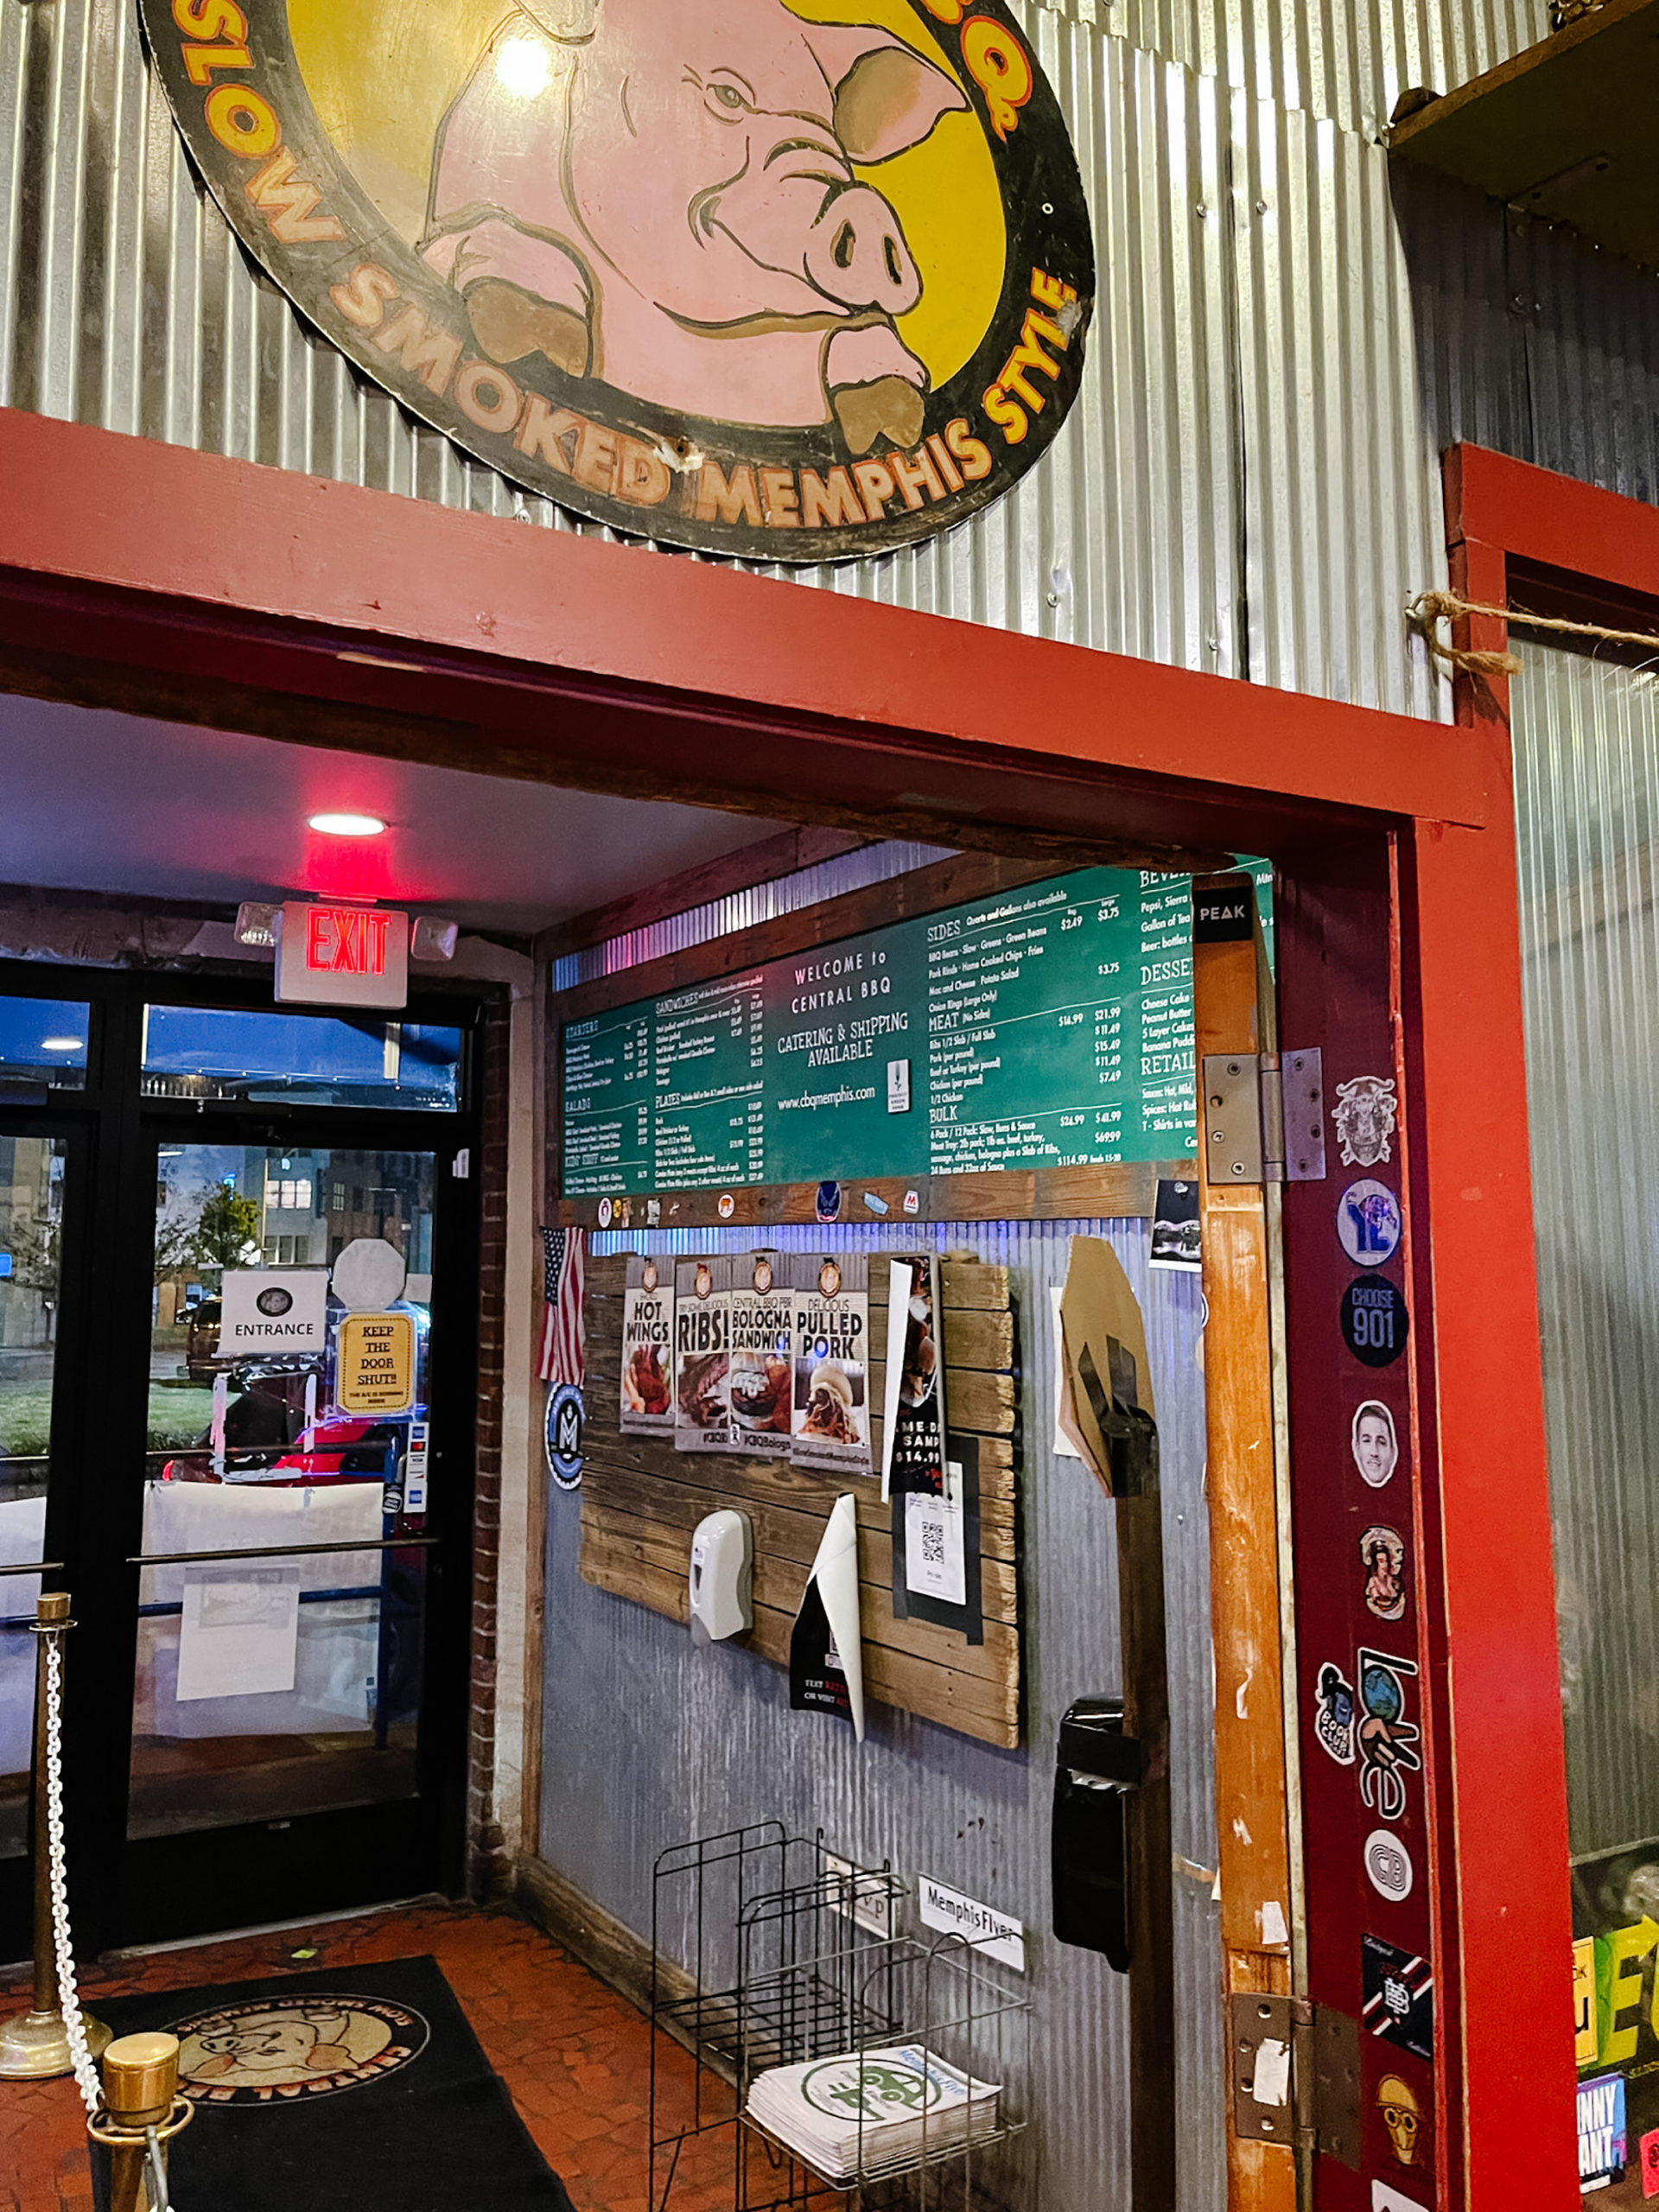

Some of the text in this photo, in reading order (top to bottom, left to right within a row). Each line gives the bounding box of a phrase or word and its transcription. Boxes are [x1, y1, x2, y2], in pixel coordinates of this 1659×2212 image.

[172, 0, 346, 244] SLOW
[329, 262, 671, 508] SMOKED
[694, 417, 993, 529] MEMPHIS
[1141, 894, 1188, 913] Pepsi, Sierra
[1199, 905, 1245, 921] PEAK
[927, 920, 961, 942] SIDES
[987, 907, 998, 921] and
[1037, 890, 1067, 907] available
[1098, 906, 1120, 922] $3.75
[1141, 913, 1191, 932] Gallon of Tea
[307, 908, 391, 976] EXIT
[1006, 932, 1026, 943] Green
[1141, 933, 1187, 953] Beer: bottles
[1005, 950, 1023, 963] Chips
[1027, 944, 1044, 957] Fries
[794, 953, 863, 986] WELCOME
[1098, 962, 1120, 975] $3.75
[928, 986, 942, 996] Mac
[942, 982, 954, 993] and
[1001, 966, 1020, 981] Salad
[791, 976, 891, 1014] CENTRAL BBQ
[1141, 992, 1190, 1011] Cheese Cake
[929, 1012, 959, 1033] MEAT
[1058, 1007, 1121, 1027] $14.99 $21.99
[1141, 1007, 1192, 1025] Peanut Butter
[778, 1012, 909, 1054] CATERING & SHIPPING
[1095, 1022, 1121, 1036] $11.49
[1142, 1028, 1147, 1039] 5
[1149, 1027, 1170, 1039] Layer
[808, 1039, 874, 1068] AVAILABLE
[1095, 1039, 1121, 1052] $15.49
[1142, 1039, 1171, 1053] Banana
[1095, 1054, 1121, 1067] $11.49
[1141, 1051, 1196, 1076] RETAIL
[1099, 1070, 1122, 1084] $7.49
[655, 1092, 681, 1109] PLATES
[778, 1084, 876, 1111] www.cbqmemphis.com
[929, 1105, 958, 1123] BULK
[1168, 1102, 1182, 1113] Hot
[1060, 1115, 1084, 1127] $24.99
[1174, 1117, 1182, 1128] in
[1058, 1154, 1088, 1166] $114.99
[809, 1299, 849, 1312] DELICIOUS
[1351, 1287, 1395, 1309] CHOOSE
[634, 1301, 662, 1320] HOT
[733, 1310, 792, 1329] BOLOGNA
[234, 1323, 314, 1337] ENTRANCE
[361, 1325, 395, 1338] KEEP
[627, 1321, 668, 1342] WINGS
[678, 1309, 729, 1352] RIBS!
[798, 1312, 862, 1336] PULLED
[1353, 1307, 1395, 1348] 901
[365, 1342, 391, 1353] THE
[732, 1330, 791, 1350] SANDWICH
[803, 1335, 855, 1359] PORK
[360, 1357, 394, 1370] DOOR
